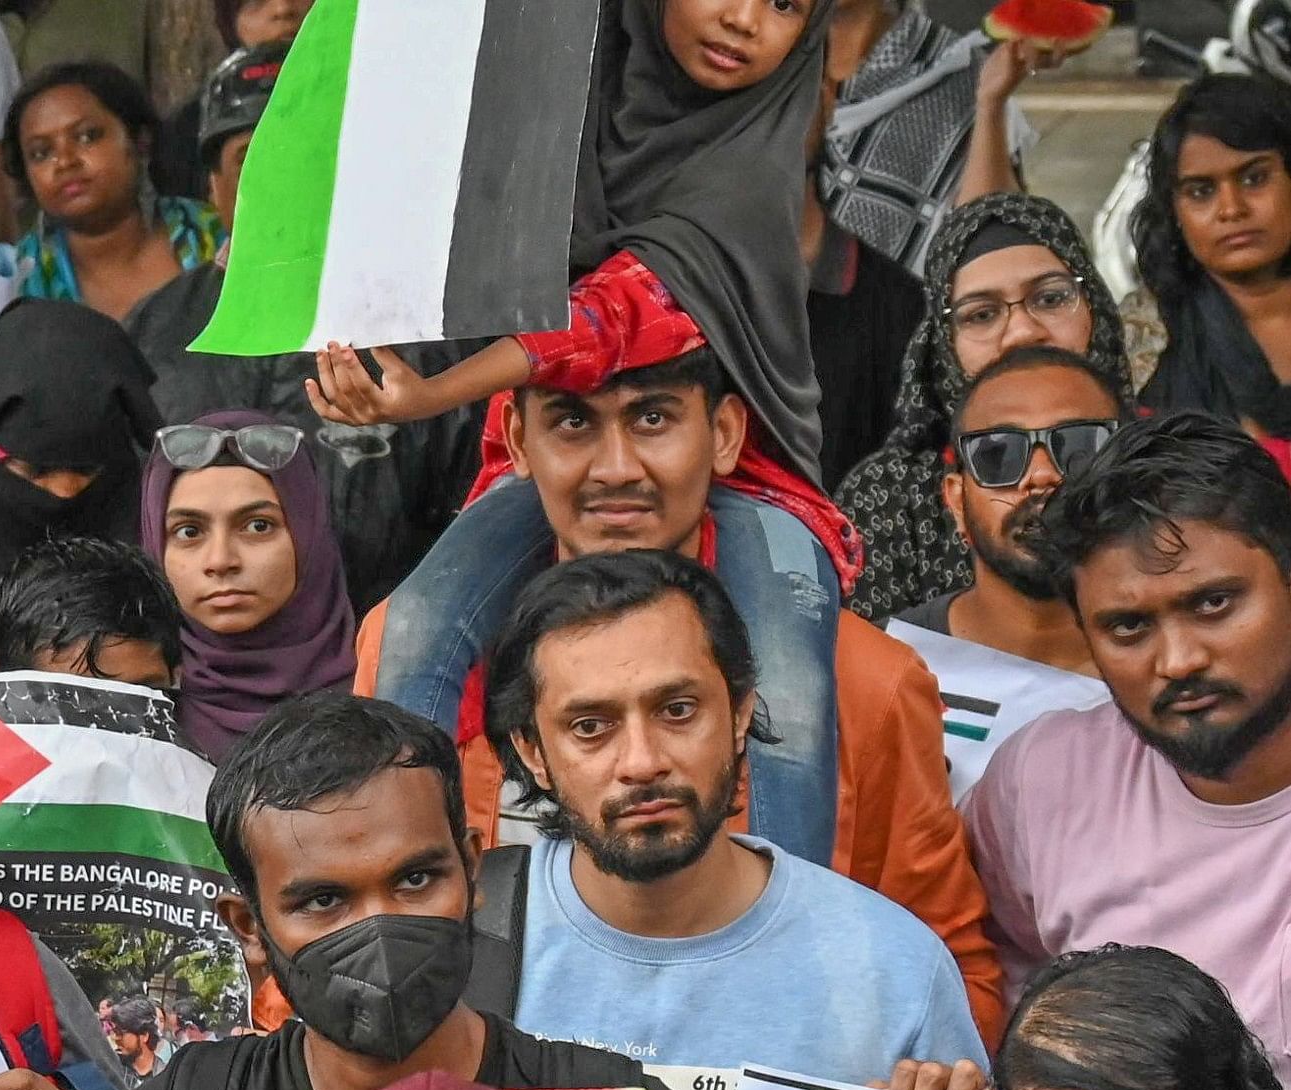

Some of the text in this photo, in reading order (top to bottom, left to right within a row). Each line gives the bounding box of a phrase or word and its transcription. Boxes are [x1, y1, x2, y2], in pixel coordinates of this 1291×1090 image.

[10, 863, 55, 882] THE
[59, 864, 184, 894] BANGALORE
[8, 891, 39, 910] OF
[42, 893, 86, 912] THE
[90, 894, 196, 928] PALESTINE
[624, 1040, 658, 1058] York
